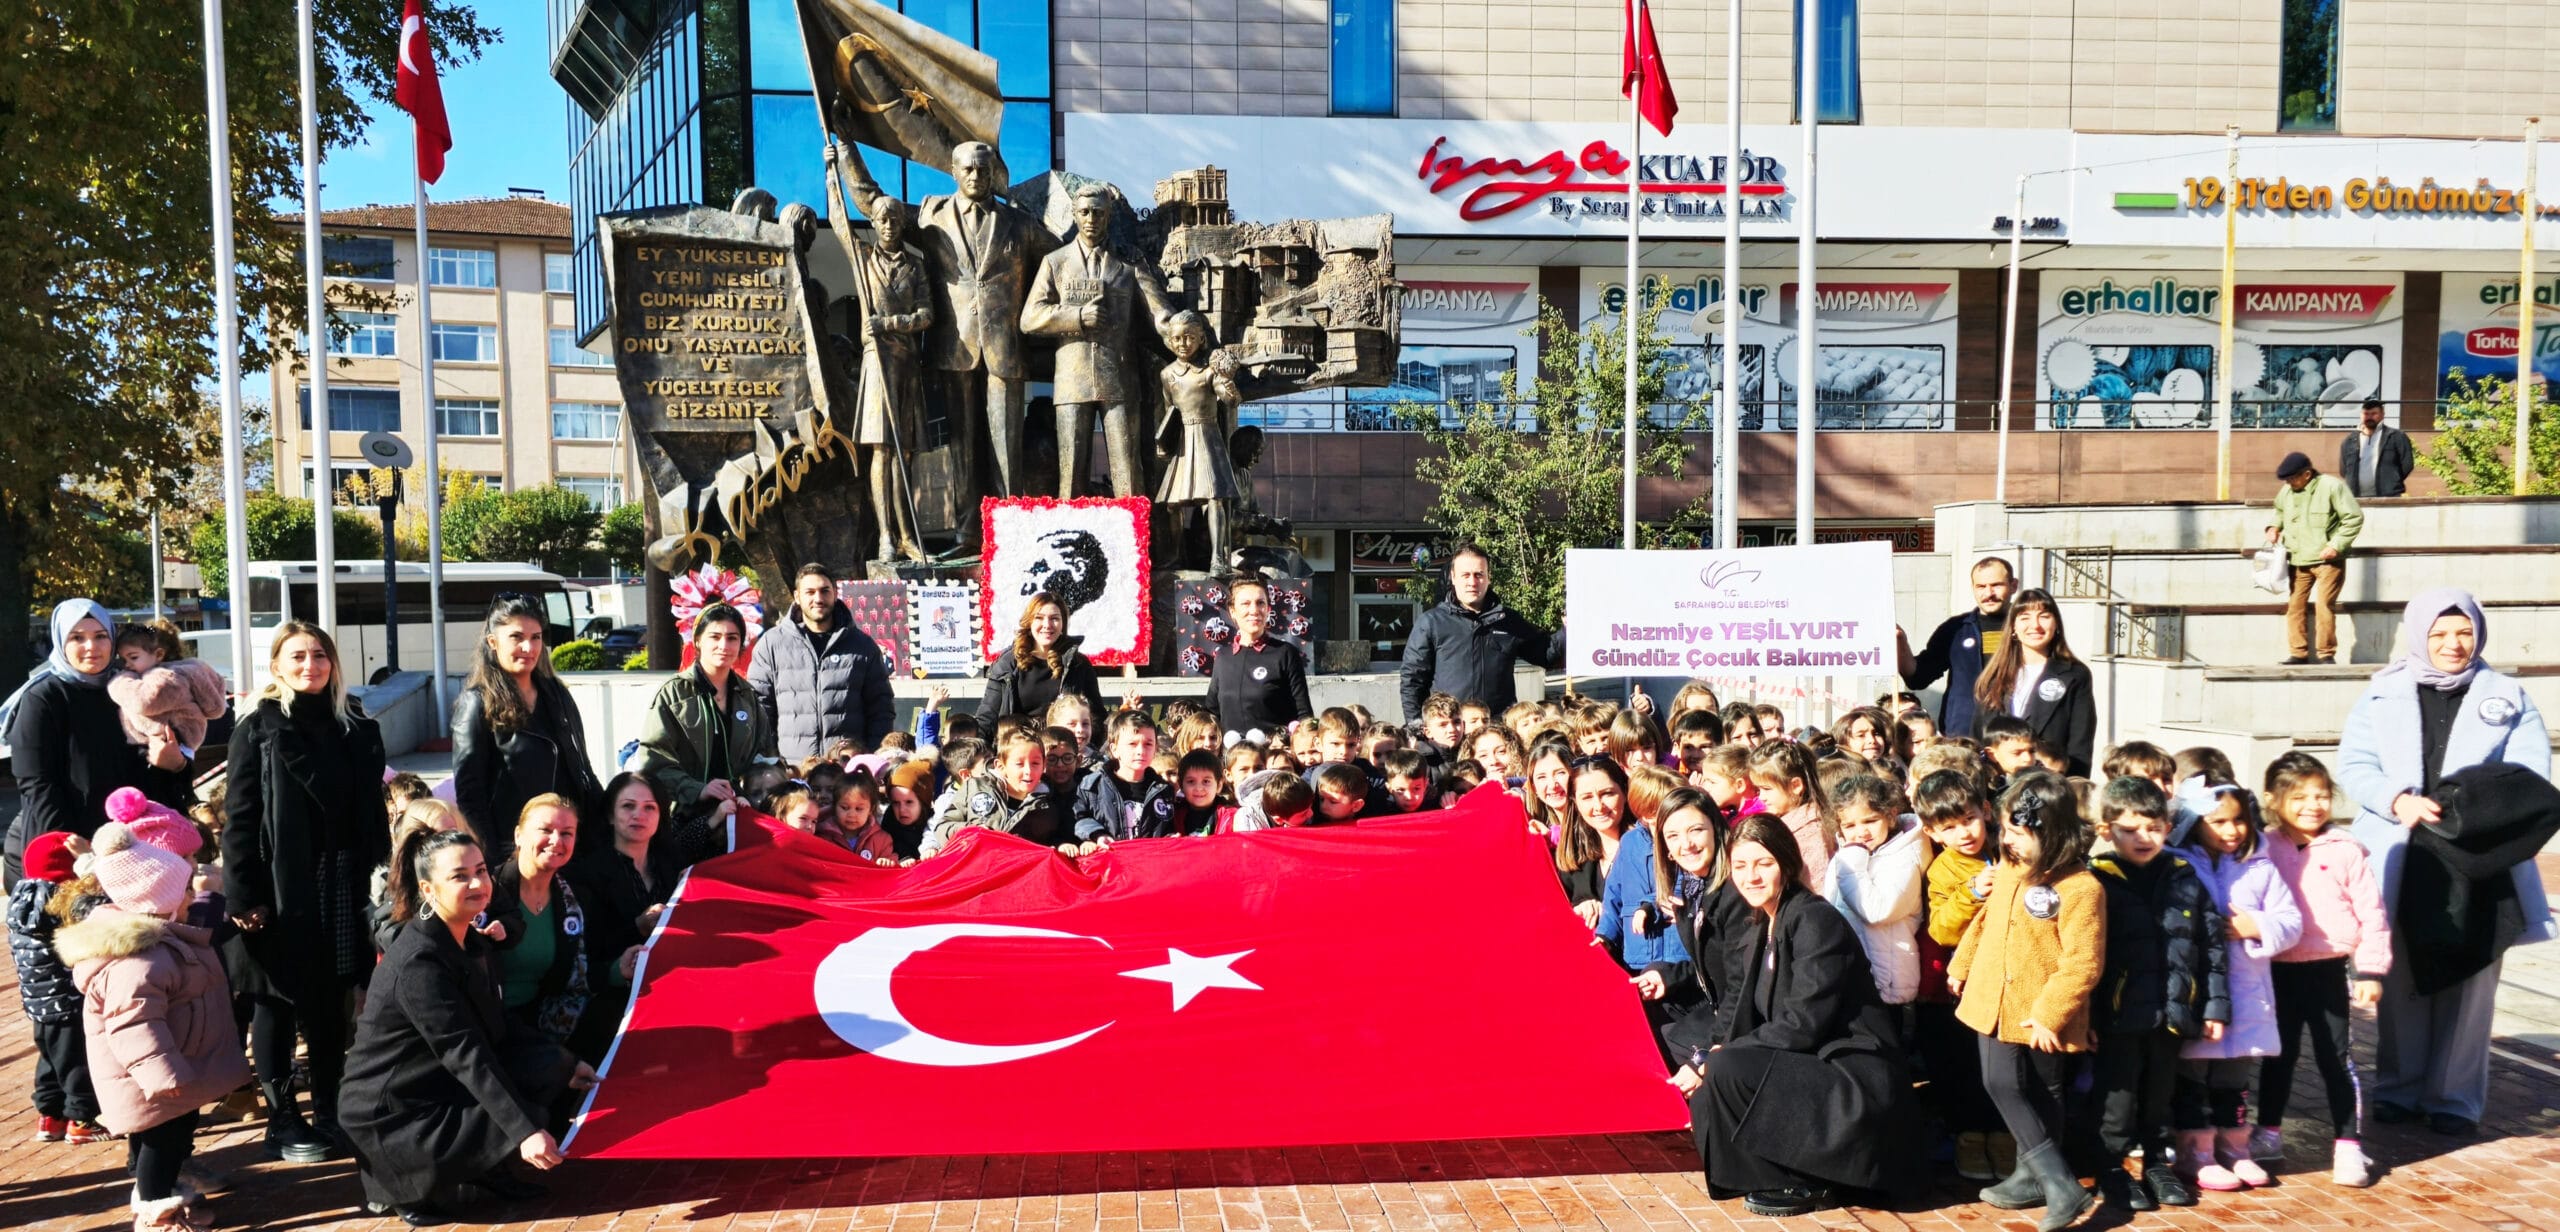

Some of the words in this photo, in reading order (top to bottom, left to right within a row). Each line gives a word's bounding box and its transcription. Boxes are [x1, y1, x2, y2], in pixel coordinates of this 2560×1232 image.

[1550, 197, 1573, 219] By
[1640, 199, 1657, 215] &
[1664, 193, 1706, 215] Ümit
[1710, 199, 1782, 215] ALAN
[637, 247, 664, 261] EY
[676, 246, 784, 266] YÜKSELEN
[652, 268, 702, 286] YENİ
[640, 291, 785, 310] CUMHURİYETİ
[1401, 289, 1497, 312] MPANYA
[1796, 291, 1919, 311] AMPANYA
[2061, 280, 2220, 315] erhallar
[2246, 292, 2364, 312] KAMPANYA
[644, 311, 681, 330] BİZ
[692, 315, 791, 337] KURDUK,
[624, 338, 669, 353] ONU
[681, 337, 804, 356] YAŞATACAK
[701, 358, 731, 372] VE
[643, 377, 782, 396] YÜCELTECEK
[1674, 601, 1735, 609] SAFRANBOLU
[1737, 598, 1789, 609] BELEDİYESİ
[1611, 623, 1713, 644] Nazmiye
[1720, 618, 1859, 643] YEŞİLYURT
[1592, 648, 1680, 667] Gündüz
[1686, 648, 1761, 670] Çocuk
[1766, 647, 1880, 667] Bakımevi
